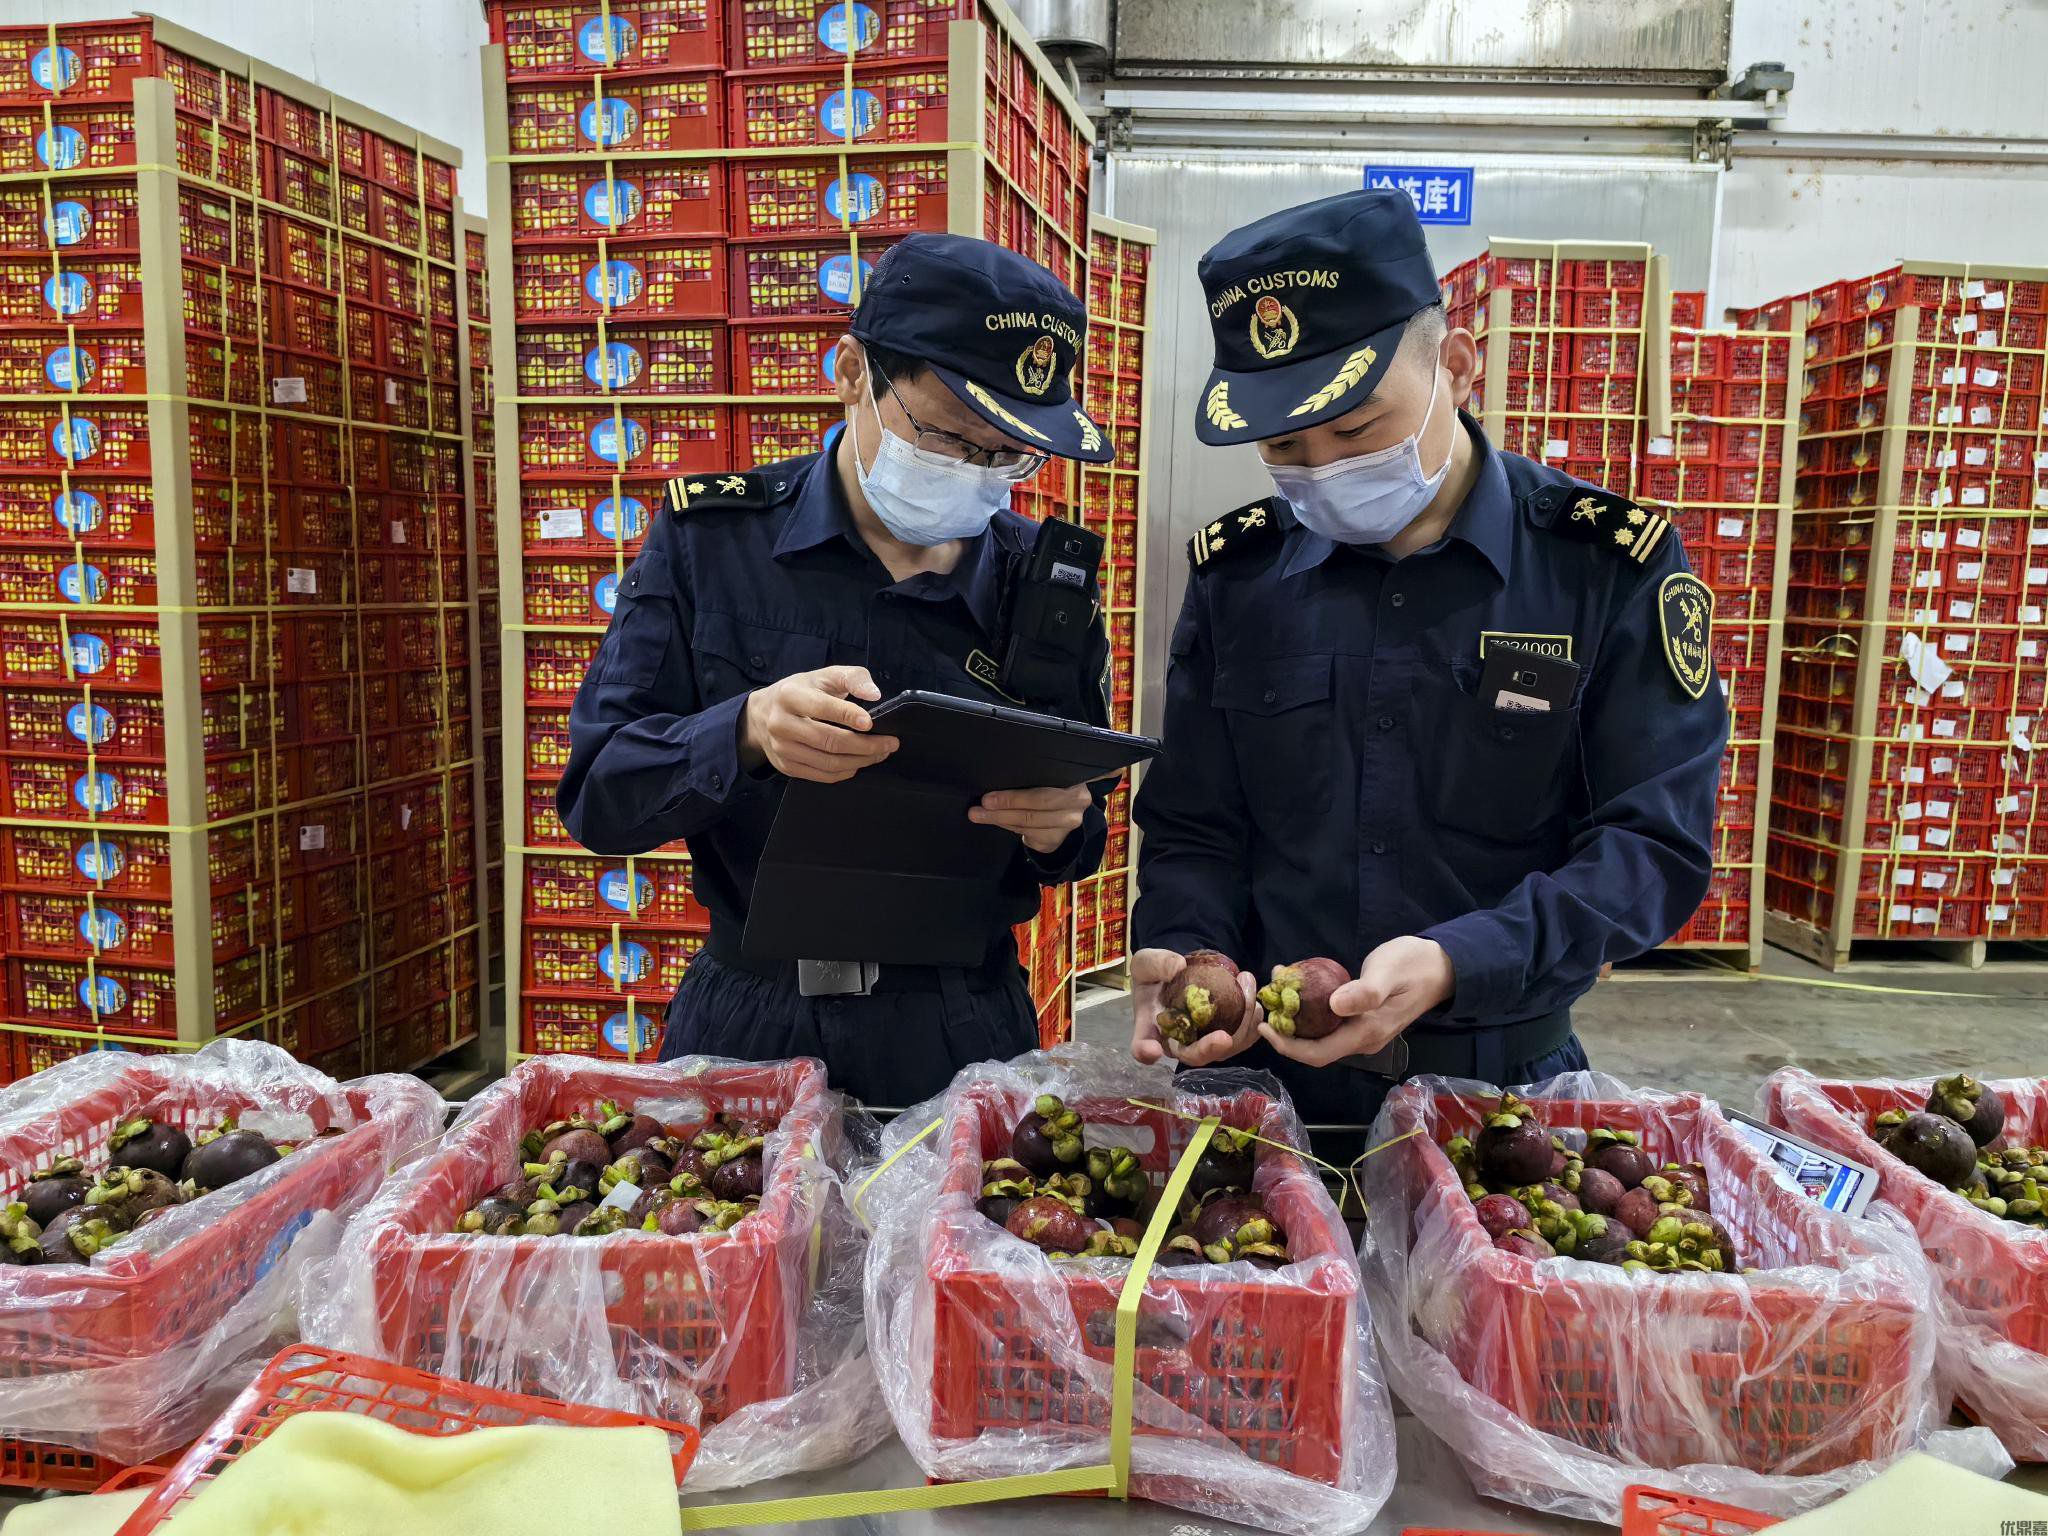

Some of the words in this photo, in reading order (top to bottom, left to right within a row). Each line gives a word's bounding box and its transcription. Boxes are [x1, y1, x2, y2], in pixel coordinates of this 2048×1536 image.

[1211, 285, 1247, 319] CHINA
[1248, 269, 1340, 294] CUSTOMS
[985, 312, 1037, 331] CHINA
[1664, 583, 1684, 602] CHINA
[1684, 583, 1710, 614] CUSTOMS
